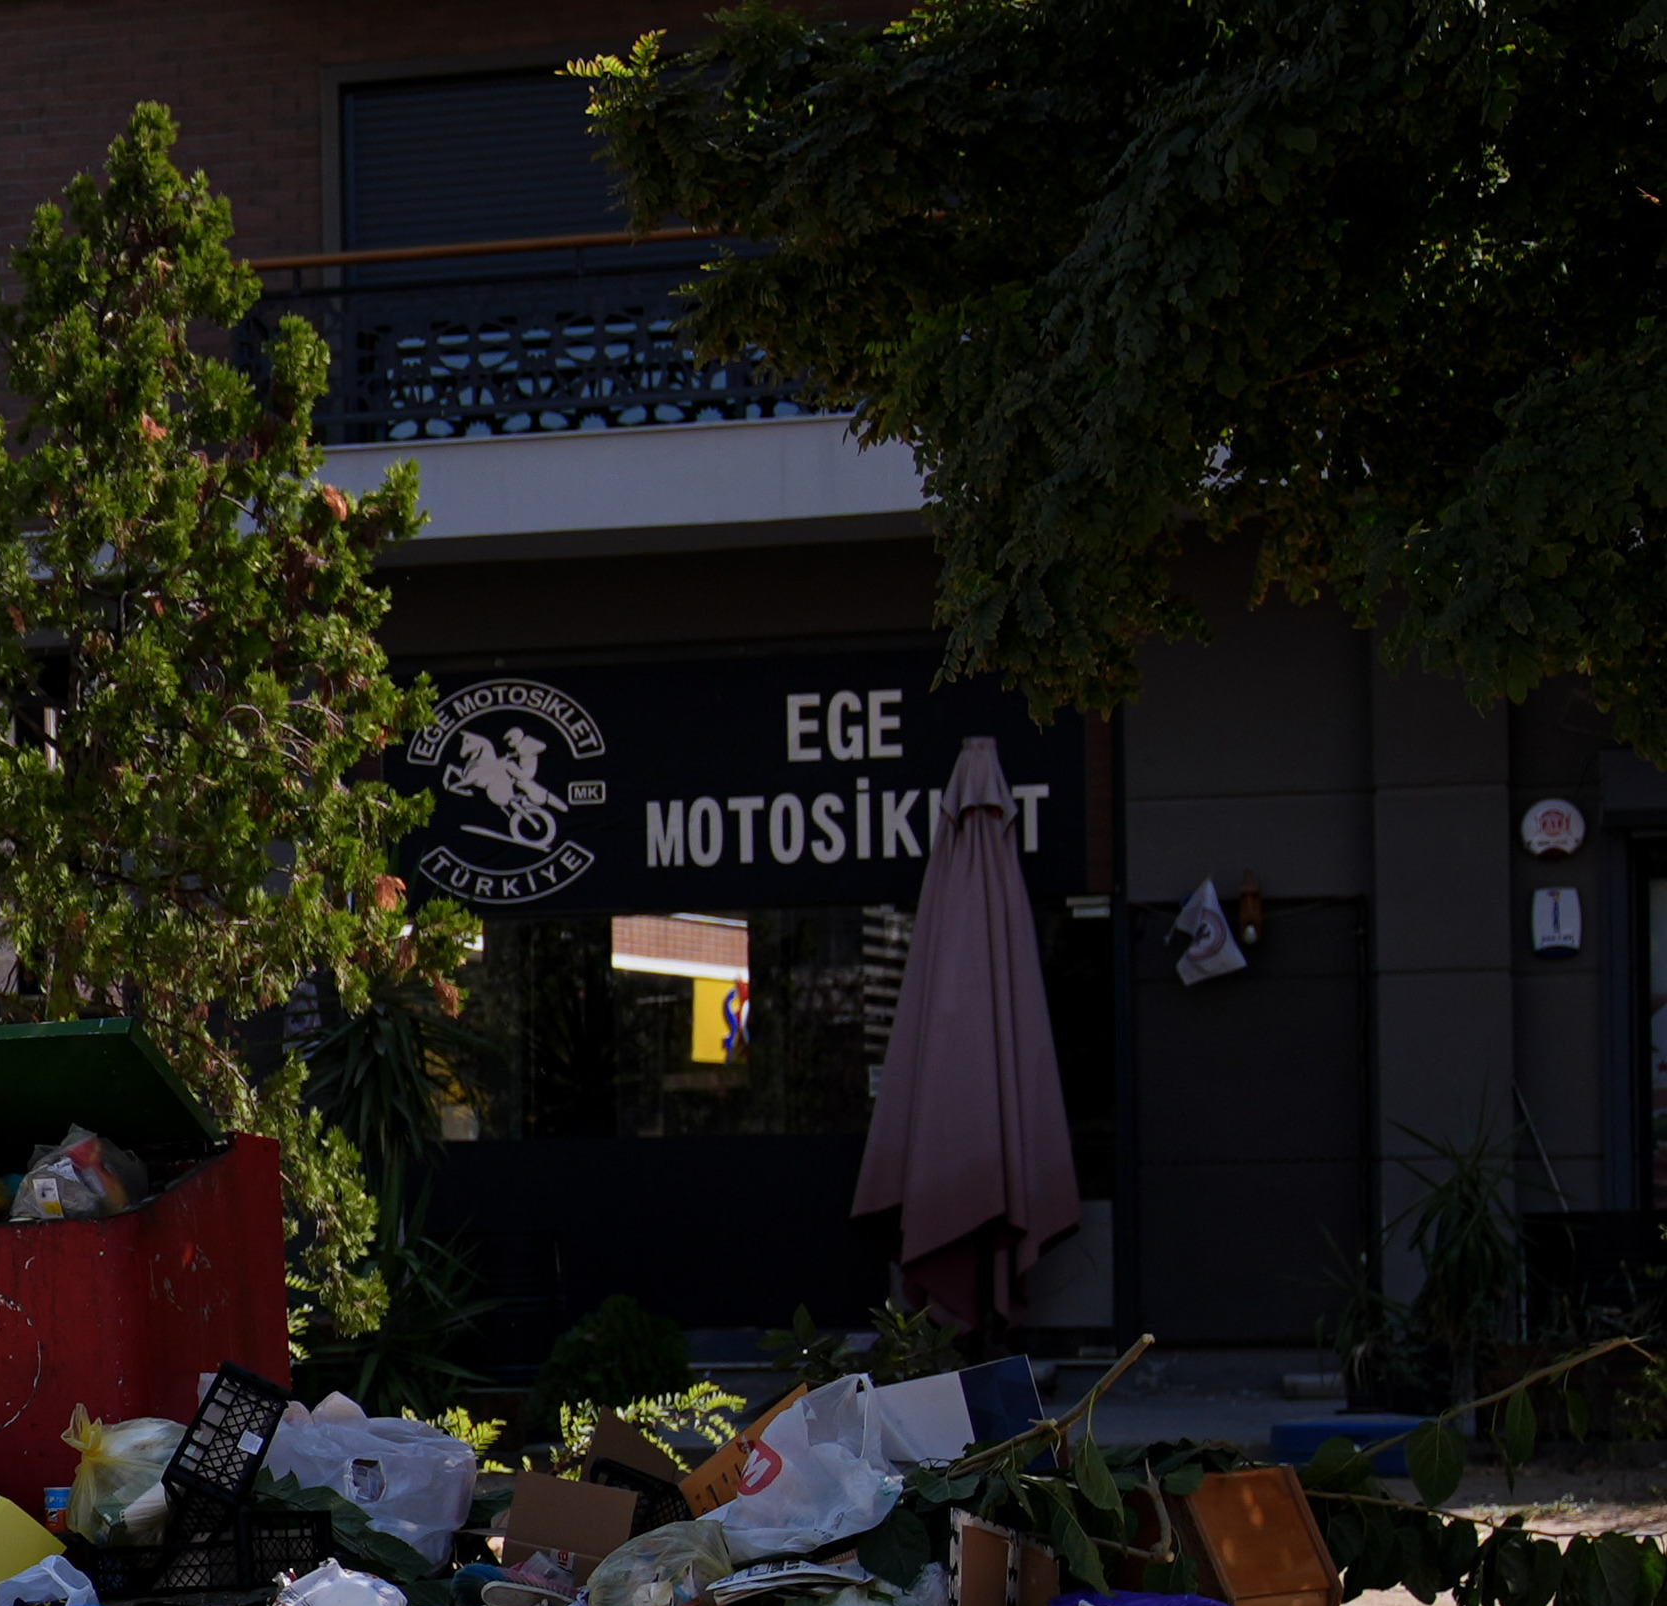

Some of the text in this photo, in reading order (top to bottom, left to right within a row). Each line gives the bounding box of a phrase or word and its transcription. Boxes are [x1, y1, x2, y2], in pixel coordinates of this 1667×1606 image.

[414, 685, 599, 758] EGE MOTOSİKLET
[786, 688, 904, 763] EGE
[573, 785, 599, 800] MK
[646, 777, 1051, 869] MOTOSİKT
[430, 850, 584, 898] TÜRKİYE
